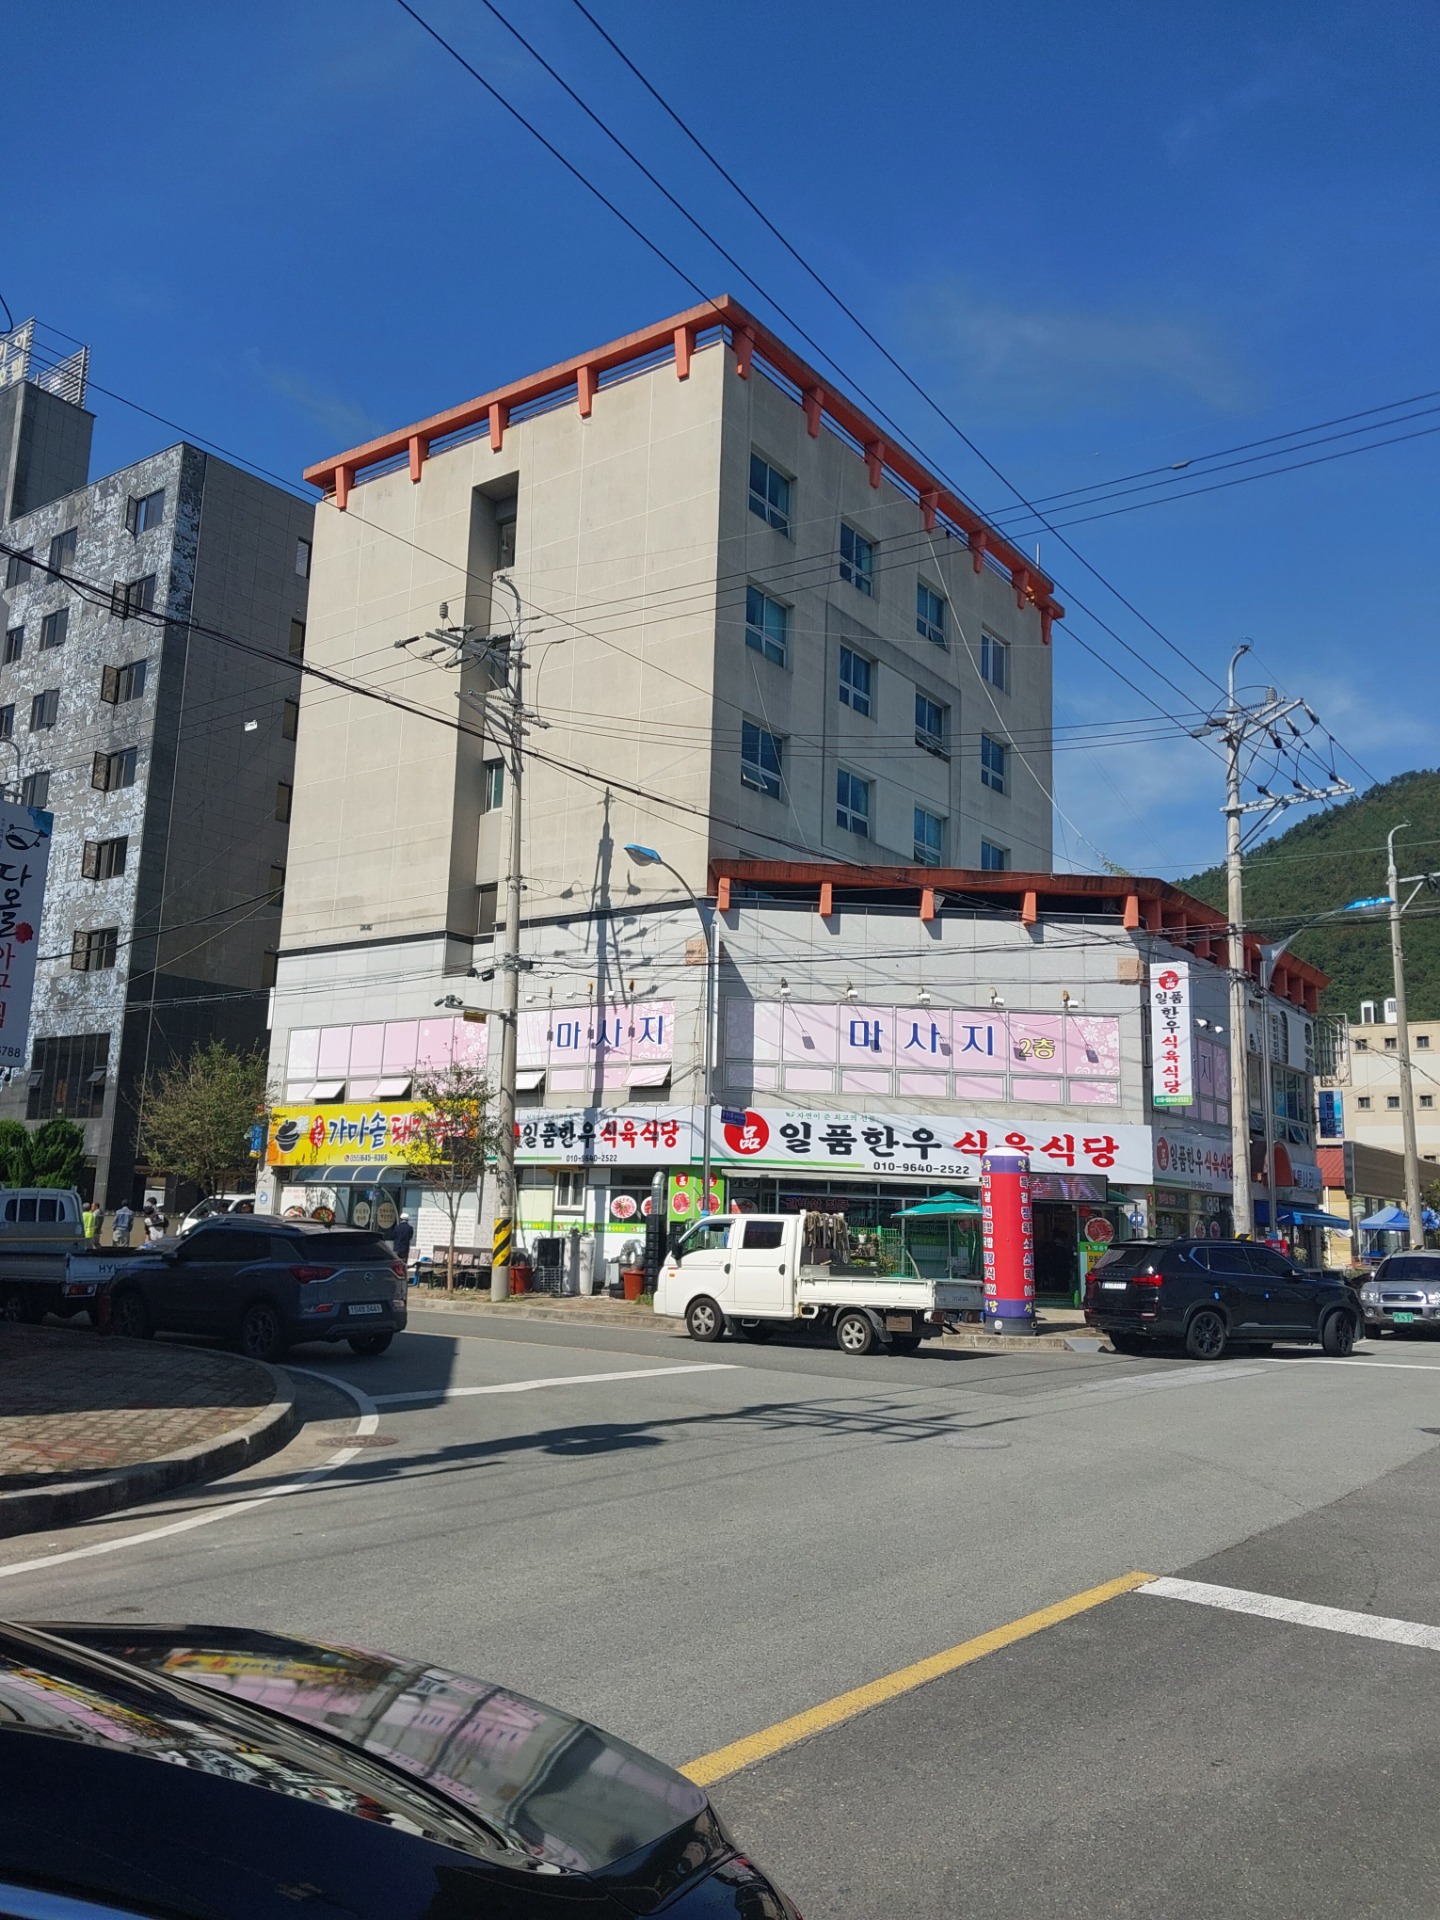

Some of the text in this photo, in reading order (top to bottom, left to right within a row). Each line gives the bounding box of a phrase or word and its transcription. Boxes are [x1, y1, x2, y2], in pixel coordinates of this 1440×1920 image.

[556, 1015, 664, 1050] 마사지
[848, 1019, 1056, 1060] 마사지 2층
[328, 1111, 387, 1149] 가마솥
[523, 1119, 680, 1149] 일품한우 식육식당
[779, 1121, 1121, 1169] 일품한우 식육식당
[566, 1154, 618, 1163] 010-9640-2522
[872, 1161, 970, 1175] 010-9640-2522
